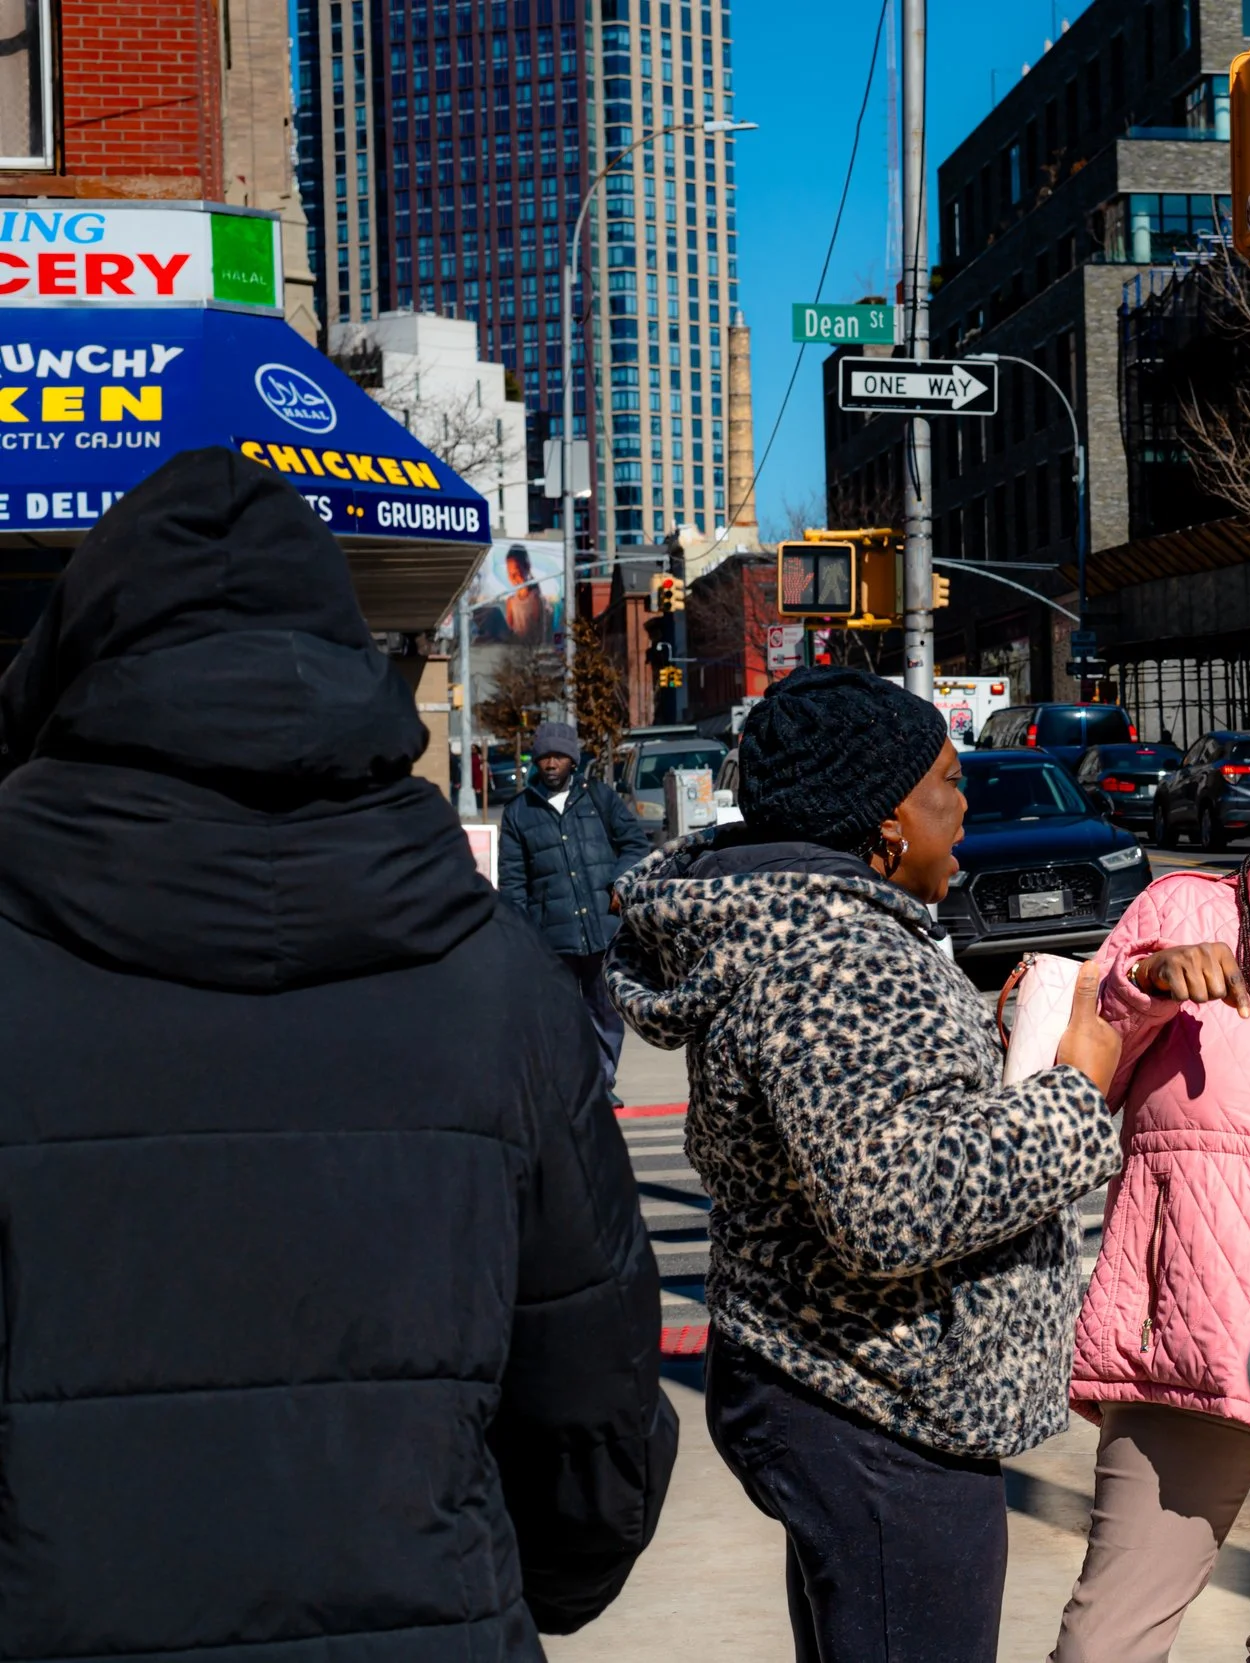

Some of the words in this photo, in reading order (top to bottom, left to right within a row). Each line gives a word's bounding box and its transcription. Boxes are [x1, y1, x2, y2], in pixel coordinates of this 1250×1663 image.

[0, 211, 106, 244] ING
[222, 269, 267, 286] HALAL
[805, 308, 859, 338] Dean
[870, 310, 885, 328] St
[0, 343, 184, 379] UNCHY
[864, 375, 907, 395] ONE
[928, 377, 972, 397] WAY
[282, 407, 330, 421] HALAL
[0, 432, 65, 449] CTLY
[75, 431, 160, 448] CAJUN
[241, 441, 441, 490] CHICKEN
[26, 491, 124, 520] DELI
[300, 494, 333, 522] TS
[377, 501, 480, 532] GRUBHUB
